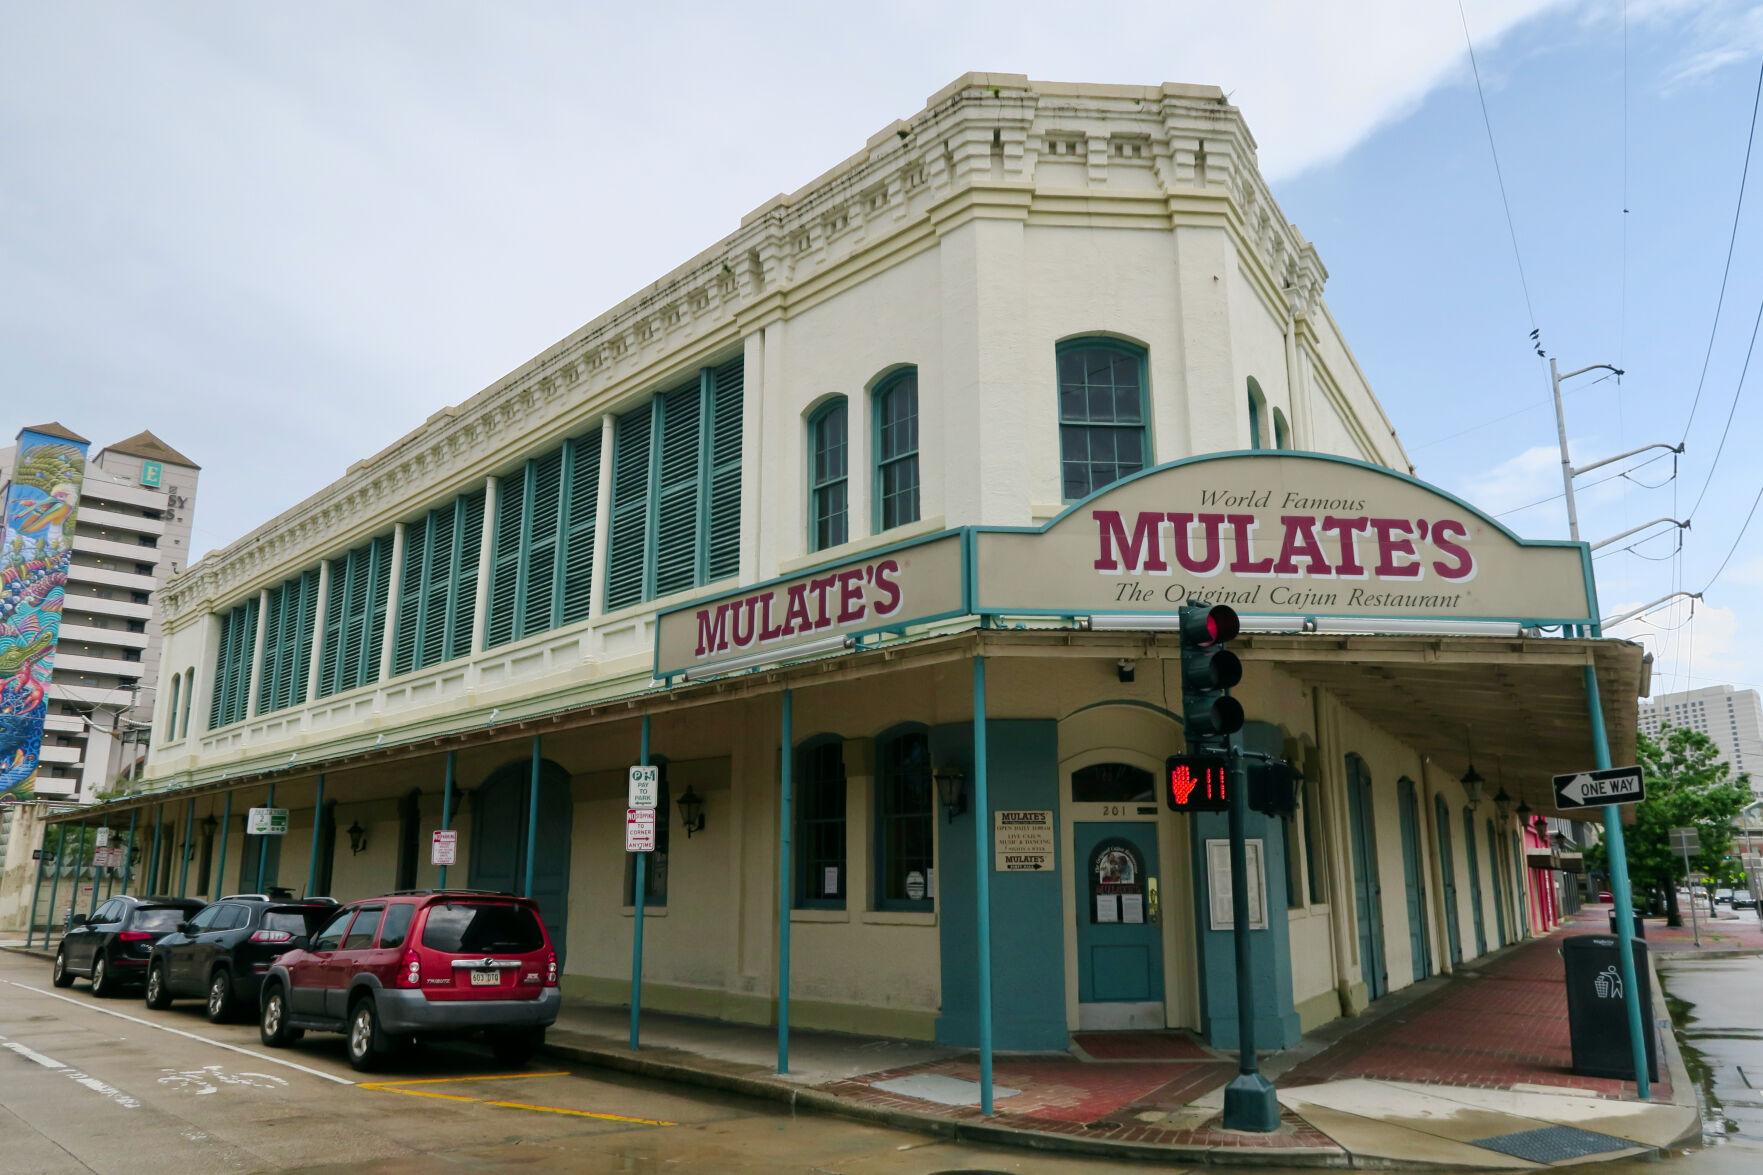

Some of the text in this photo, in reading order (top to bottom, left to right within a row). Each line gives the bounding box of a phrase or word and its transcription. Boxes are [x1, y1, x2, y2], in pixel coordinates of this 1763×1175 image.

[1201, 490, 1366, 511] World Famous
[1092, 510, 1475, 580] MULATE'S
[694, 559, 902, 658] MULATE'S
[1114, 582, 1464, 609] The Original Cajun Restaurant
[1205, 767, 1226, 800] 11
[1581, 778, 1635, 797] ONE WAY
[1103, 805, 1126, 816] 201
